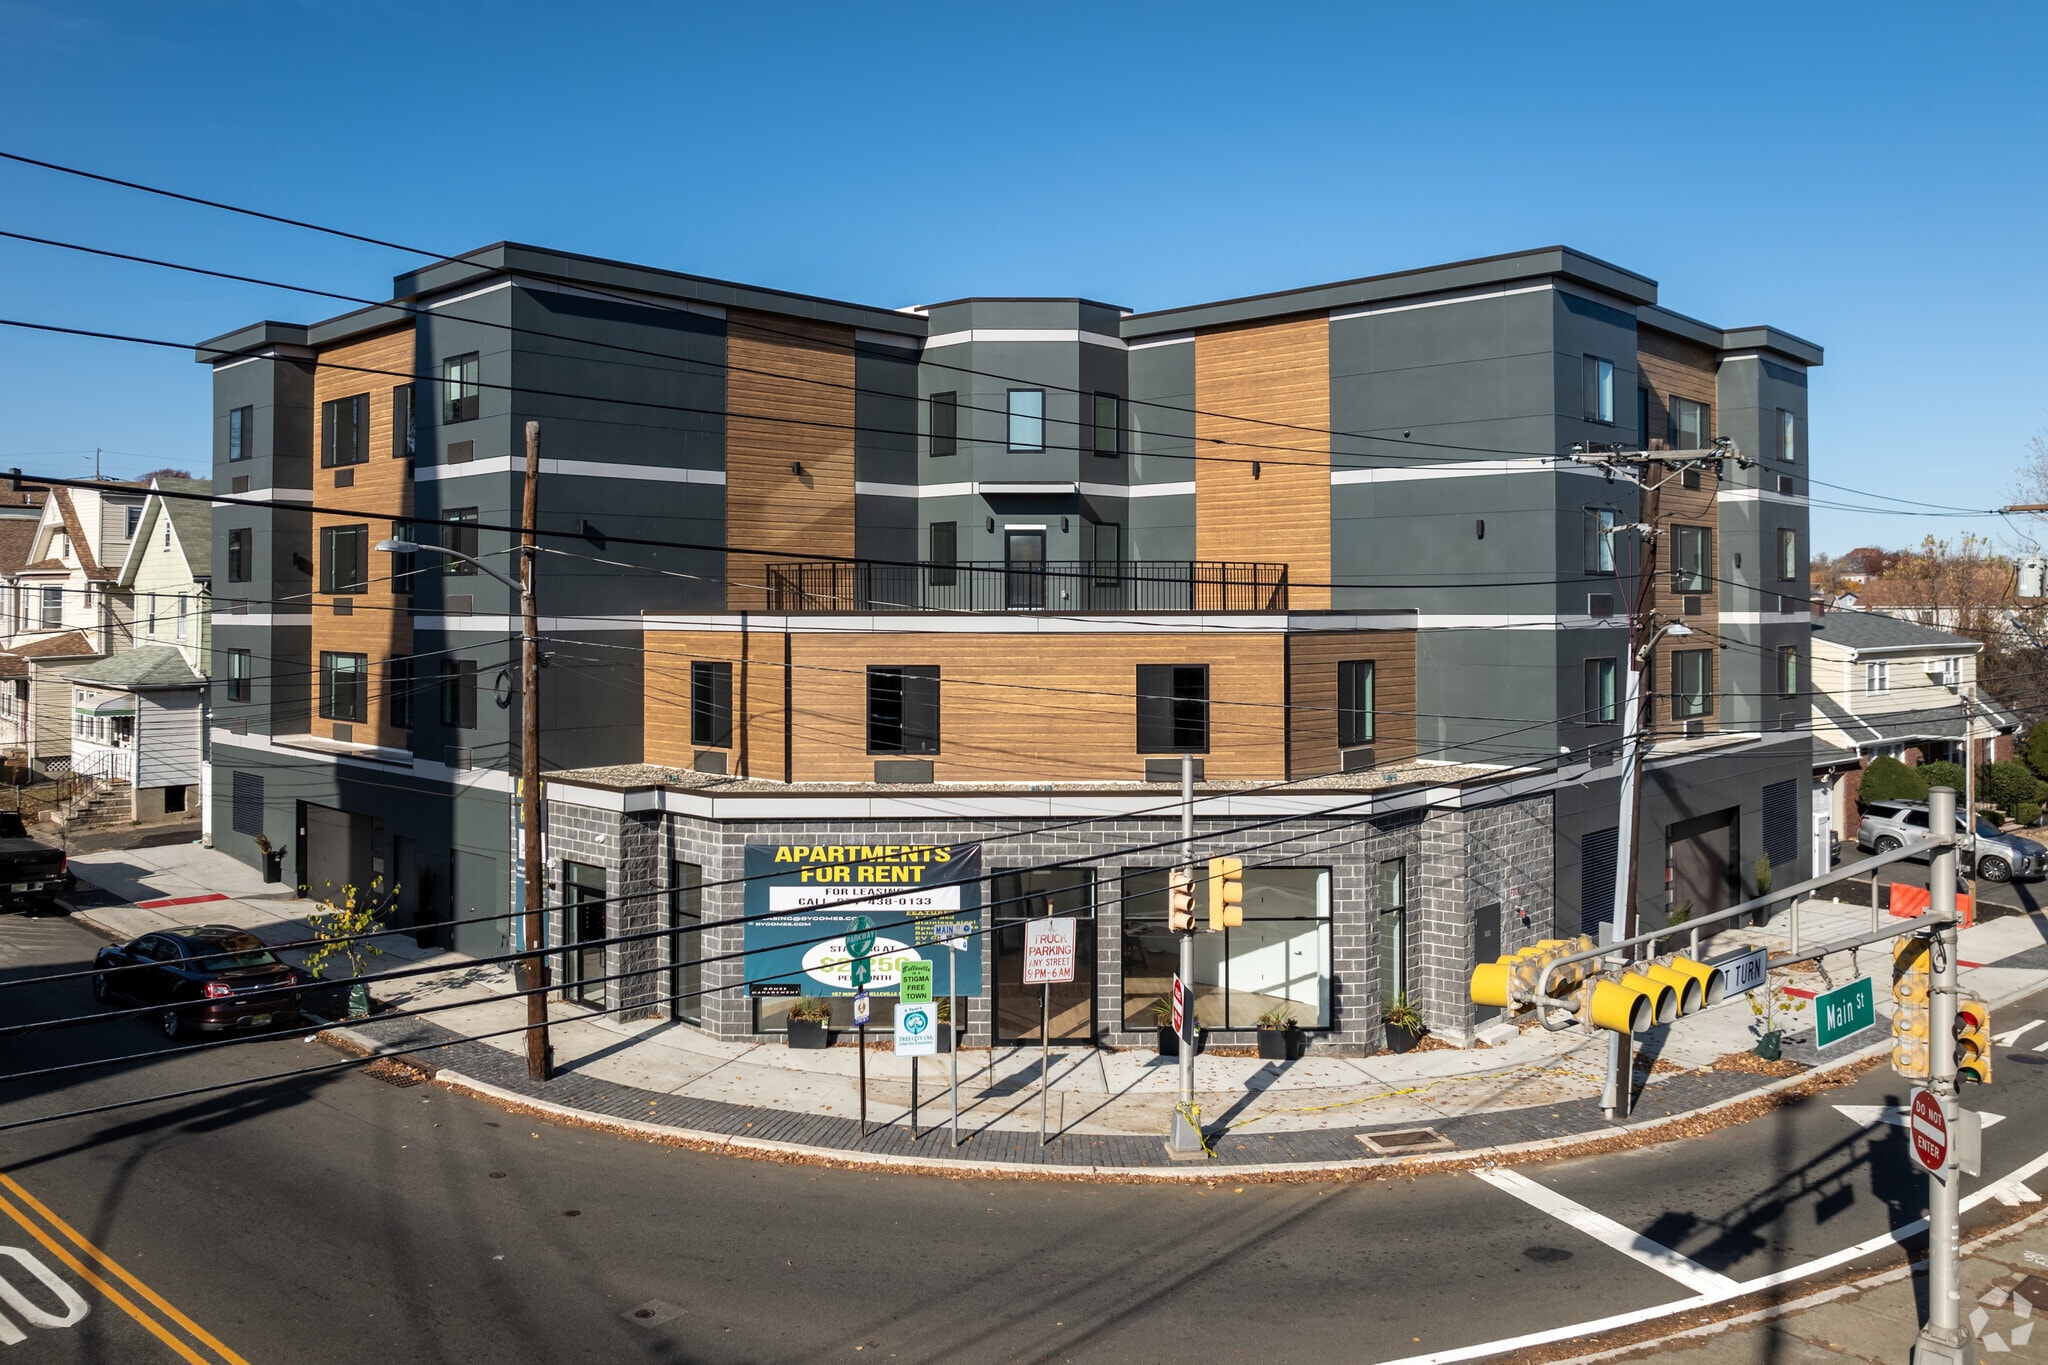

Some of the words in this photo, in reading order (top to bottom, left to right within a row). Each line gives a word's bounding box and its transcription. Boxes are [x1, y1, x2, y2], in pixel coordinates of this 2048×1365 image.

[774, 845, 951, 863] APARTMENTS
[801, 865, 850, 882] FOR
[857, 865, 926, 882] RENT
[935, 926, 954, 935] MAIN
[1034, 934, 1067, 944] TRUCK
[1029, 945, 1071, 957] PARKING
[1029, 959, 1043, 967] ANY
[1046, 958, 1070, 966] STREET
[902, 965, 931, 974] Belleville
[1736, 958, 1761, 987] TURN
[903, 975, 930, 983] STIGMA
[907, 983, 926, 991] FREE
[1826, 999, 1854, 1031] Main
[1856, 992, 1865, 1010] St
[1916, 1100, 1926, 1116] DO
[1928, 1108, 1942, 1127] NOT
[1917, 1135, 1940, 1160] ENTER
